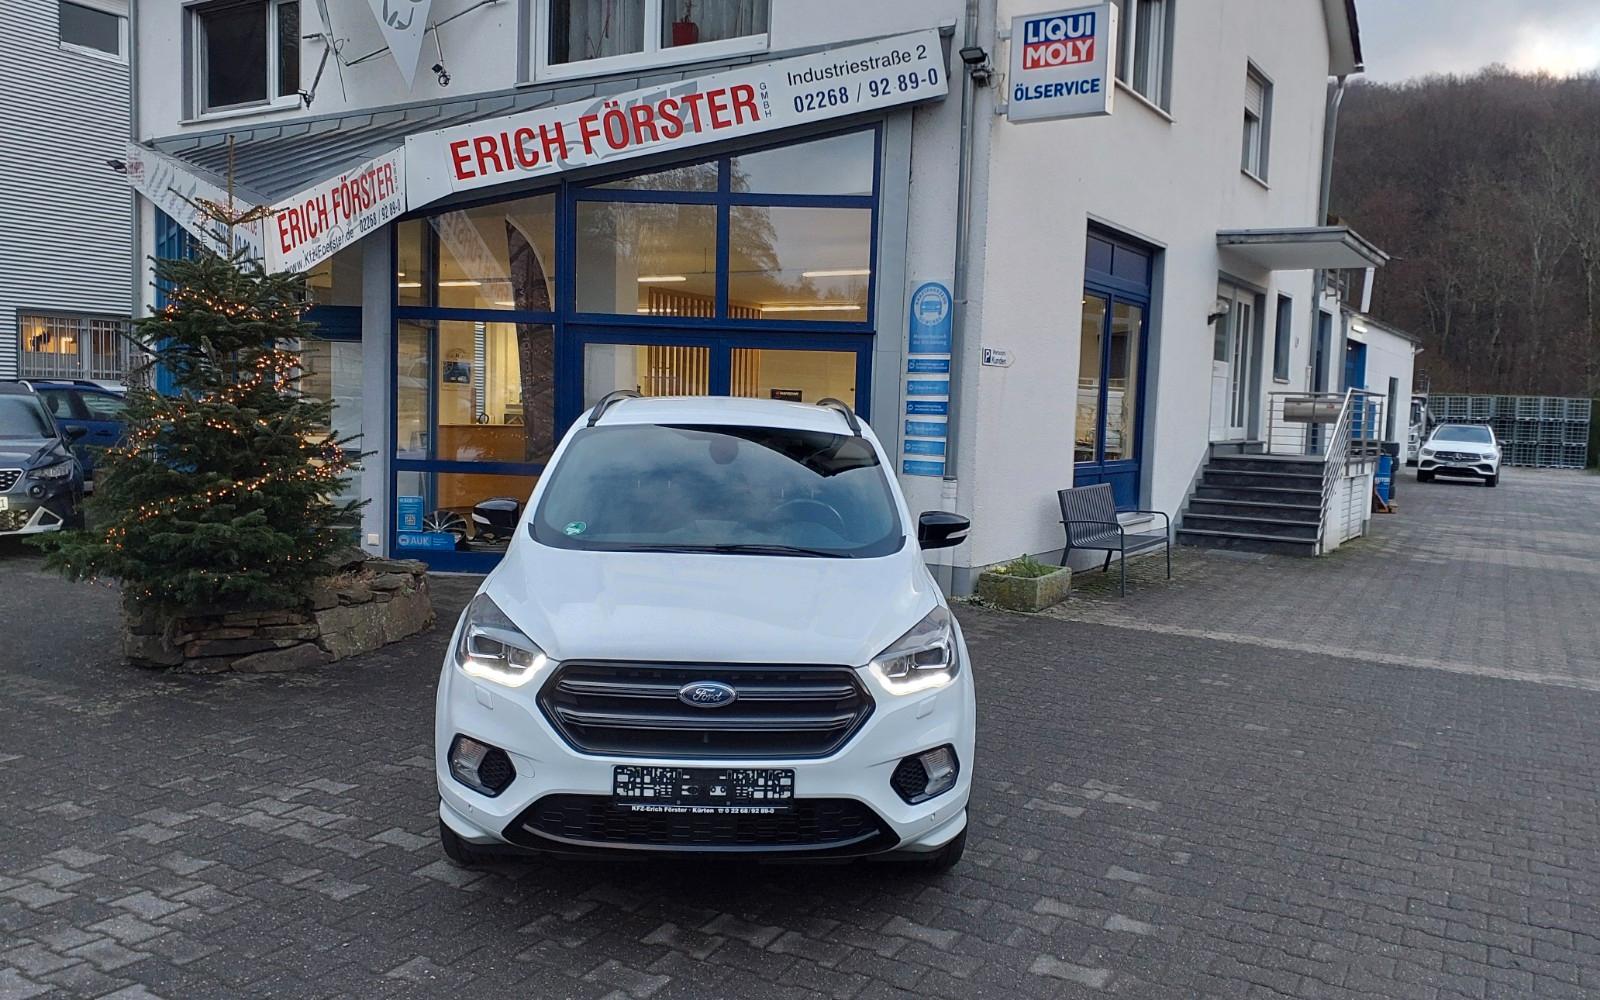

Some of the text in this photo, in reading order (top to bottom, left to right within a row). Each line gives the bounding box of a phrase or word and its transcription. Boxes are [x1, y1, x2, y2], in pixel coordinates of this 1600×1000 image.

[1027, 15, 1092, 43] LIQUI
[787, 44, 928, 86] Industriestraße 2
[1026, 39, 1093, 68] MOLY
[759, 82, 772, 119] GMBH
[794, 86, 849, 113] 02268
[869, 77, 891, 97] 92
[898, 68, 939, 92] 89-0
[1014, 78, 1101, 102] ÖLSERVICE
[450, 83, 761, 181] ERICH FÖRSTER
[276, 194, 330, 255] ERICH
[331, 162, 395, 225] FÖRSTER
[359, 211, 377, 233] 02268
[692, 687, 723, 701] Ford
